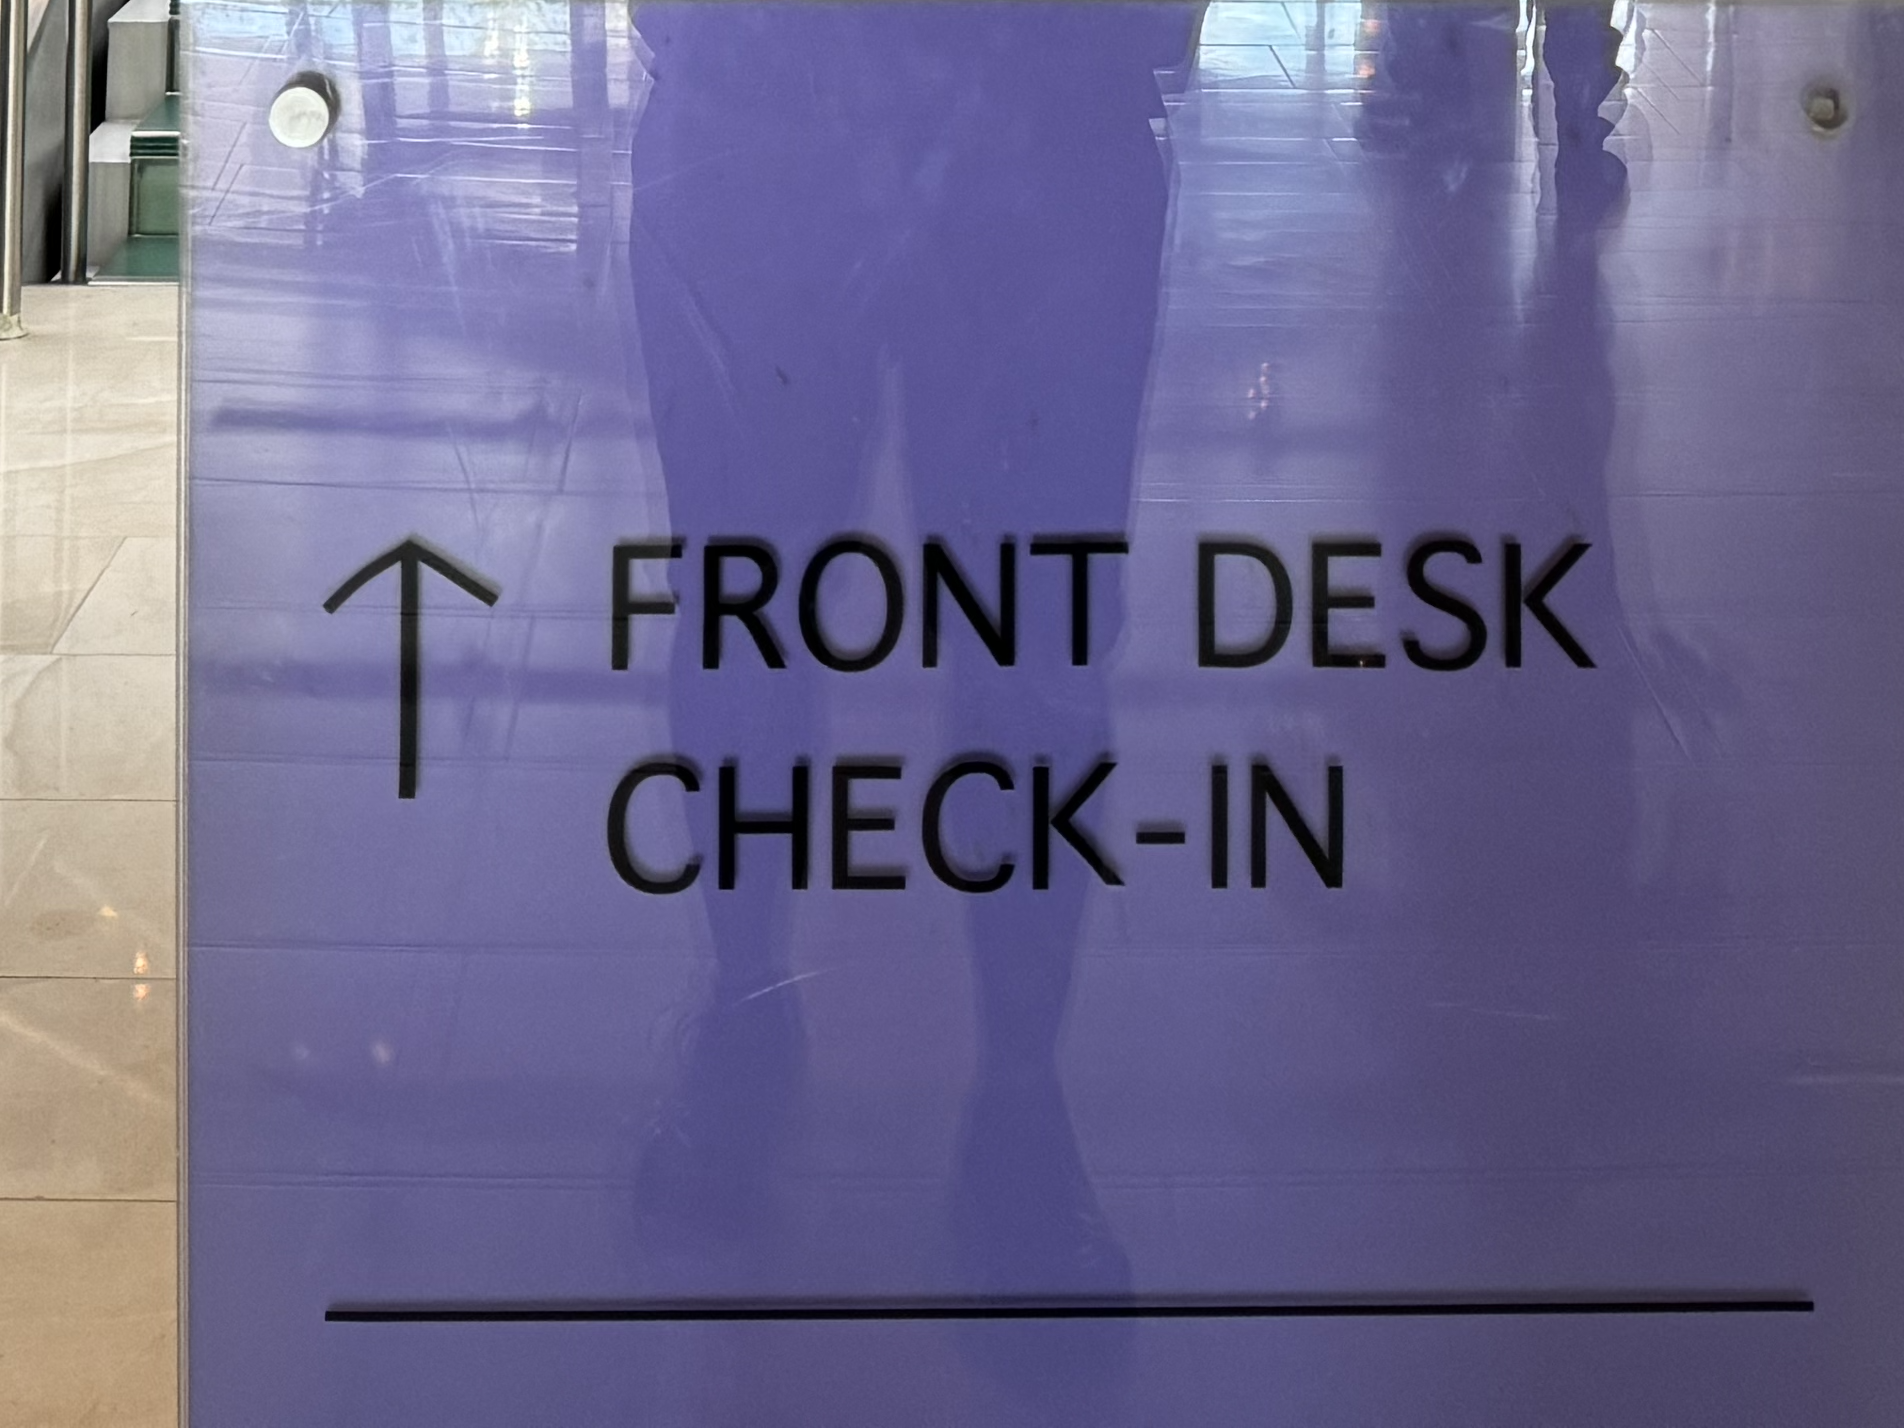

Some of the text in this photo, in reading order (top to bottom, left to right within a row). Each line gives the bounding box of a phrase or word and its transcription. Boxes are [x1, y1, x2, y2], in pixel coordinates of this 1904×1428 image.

[608, 537, 1596, 671] FRONT DESK
[606, 756, 1346, 894] CHECK-IN
